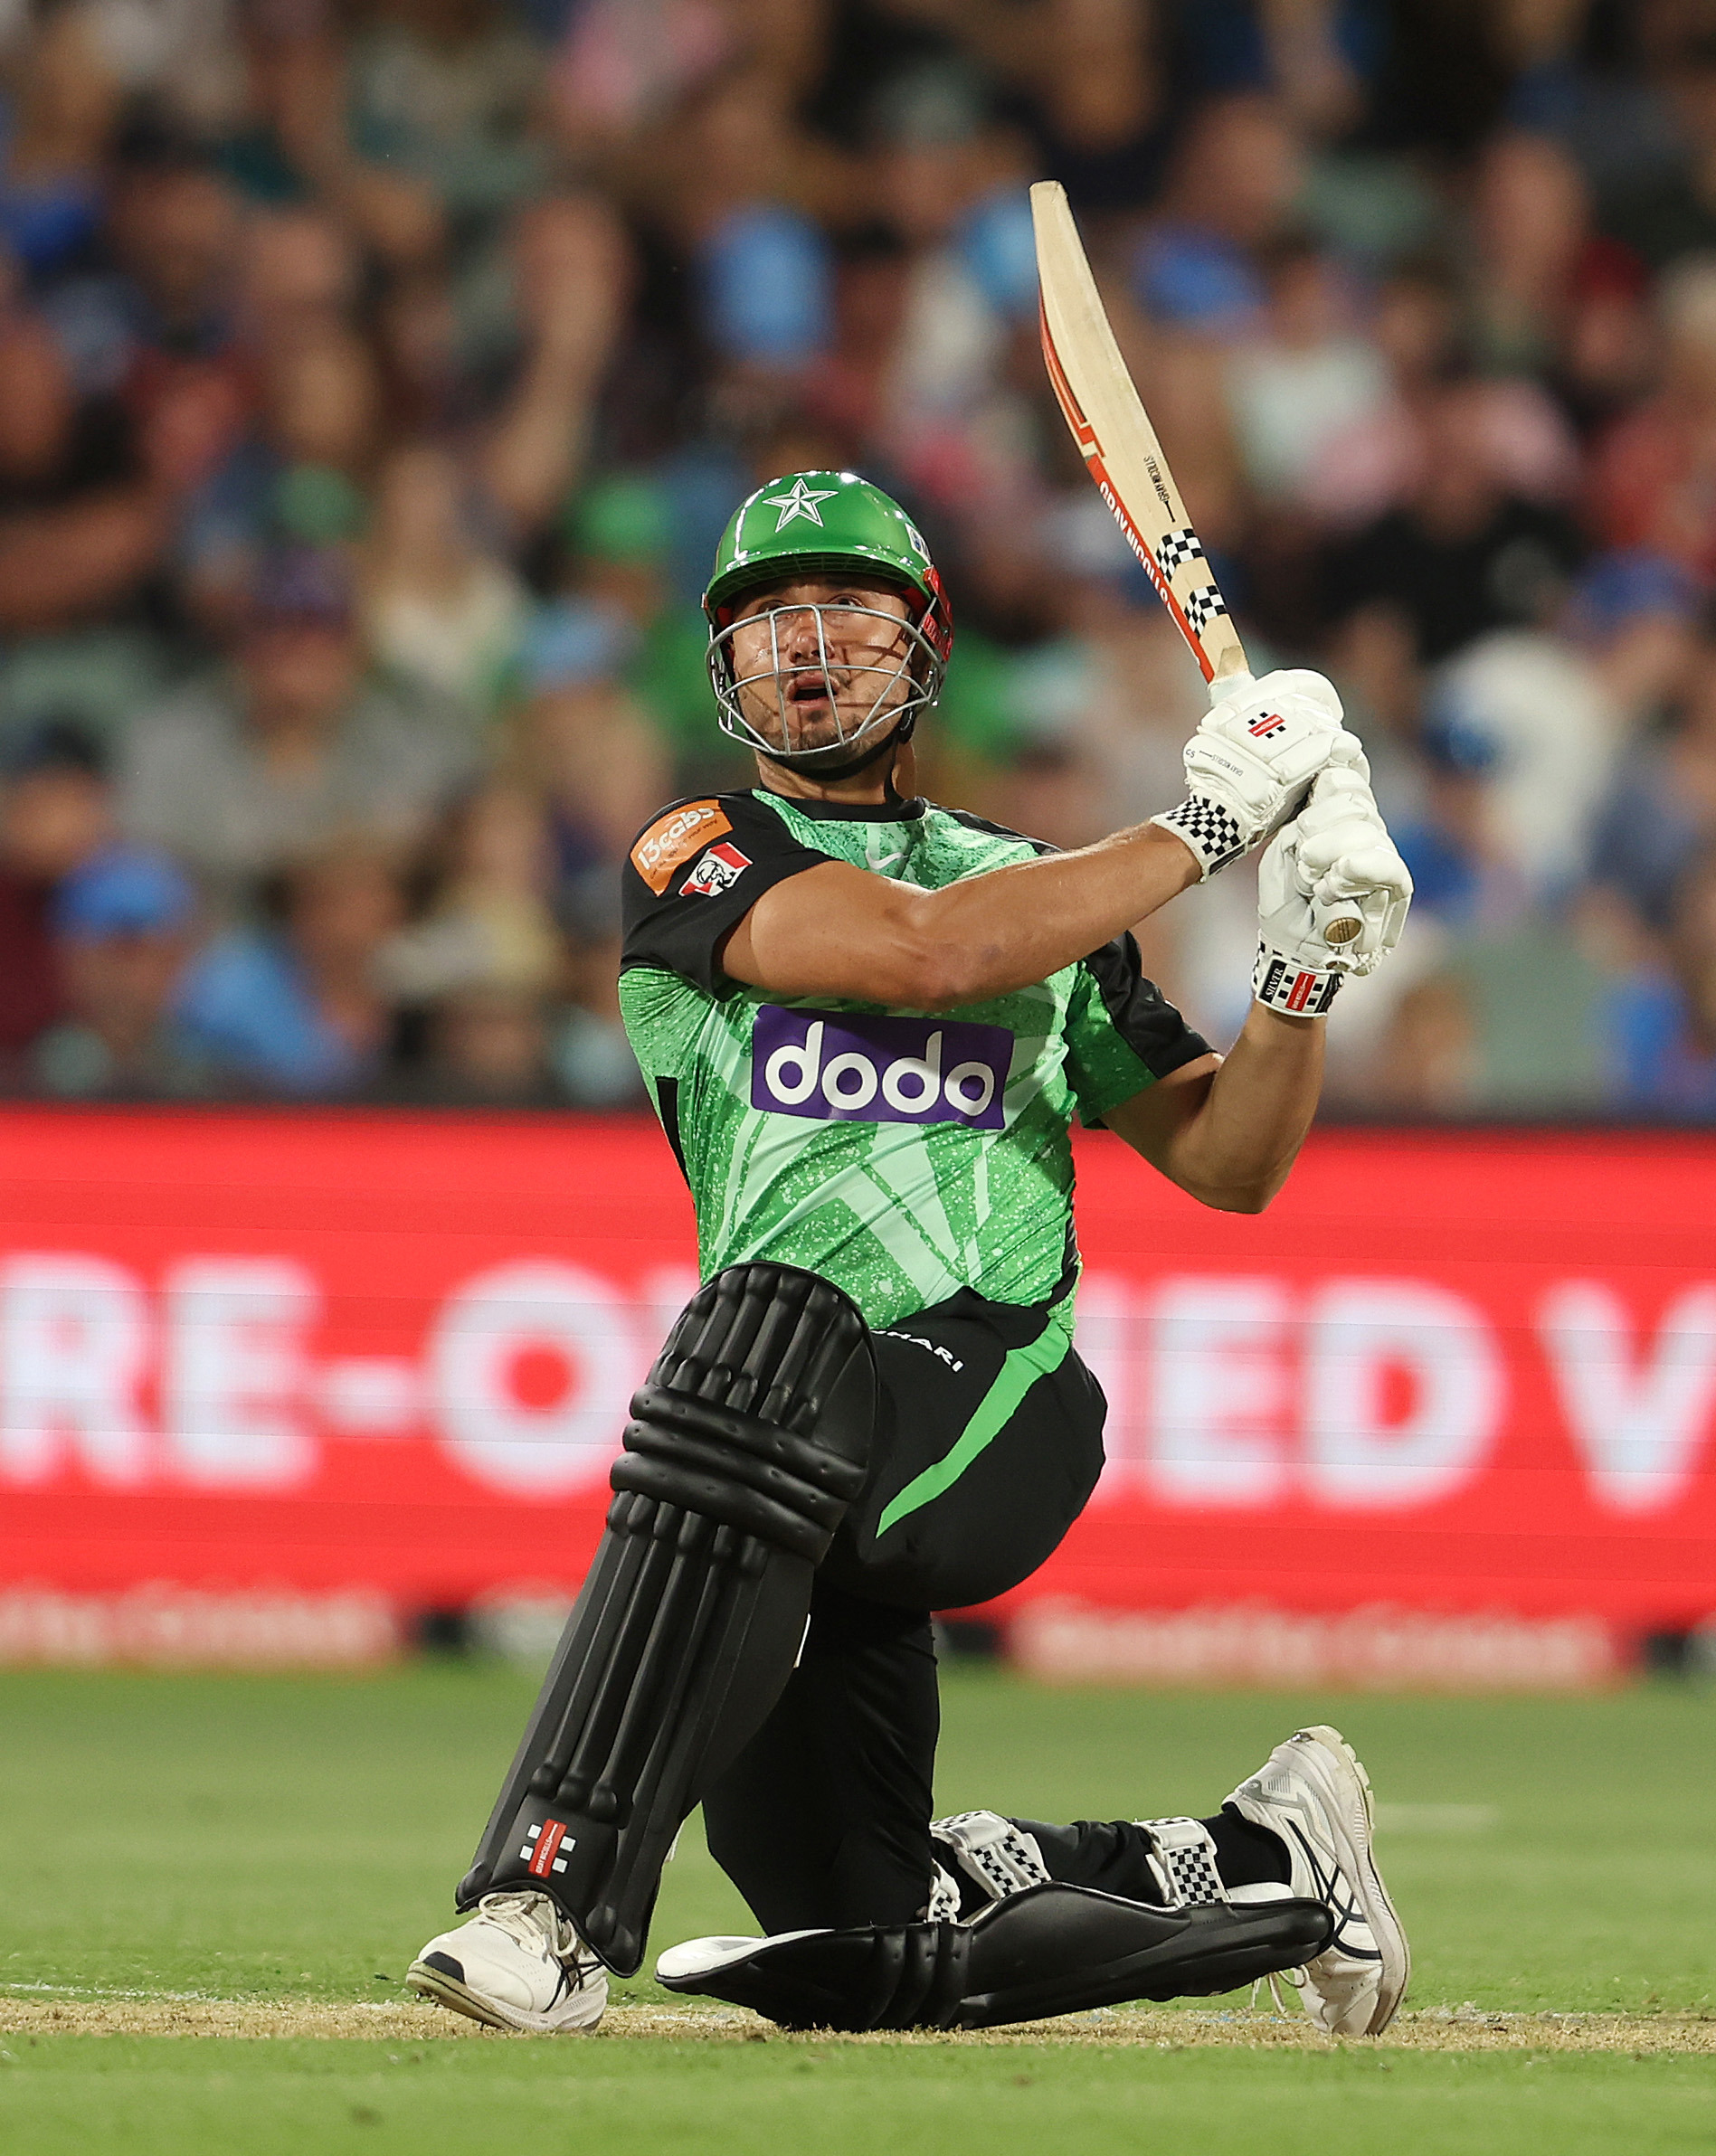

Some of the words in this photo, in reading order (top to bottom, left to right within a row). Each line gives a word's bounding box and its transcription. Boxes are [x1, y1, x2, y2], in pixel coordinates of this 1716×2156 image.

[638, 808, 715, 869] 13cabs
[1265, 968, 1284, 998] SILVER
[765, 1020, 995, 1116] dodo
